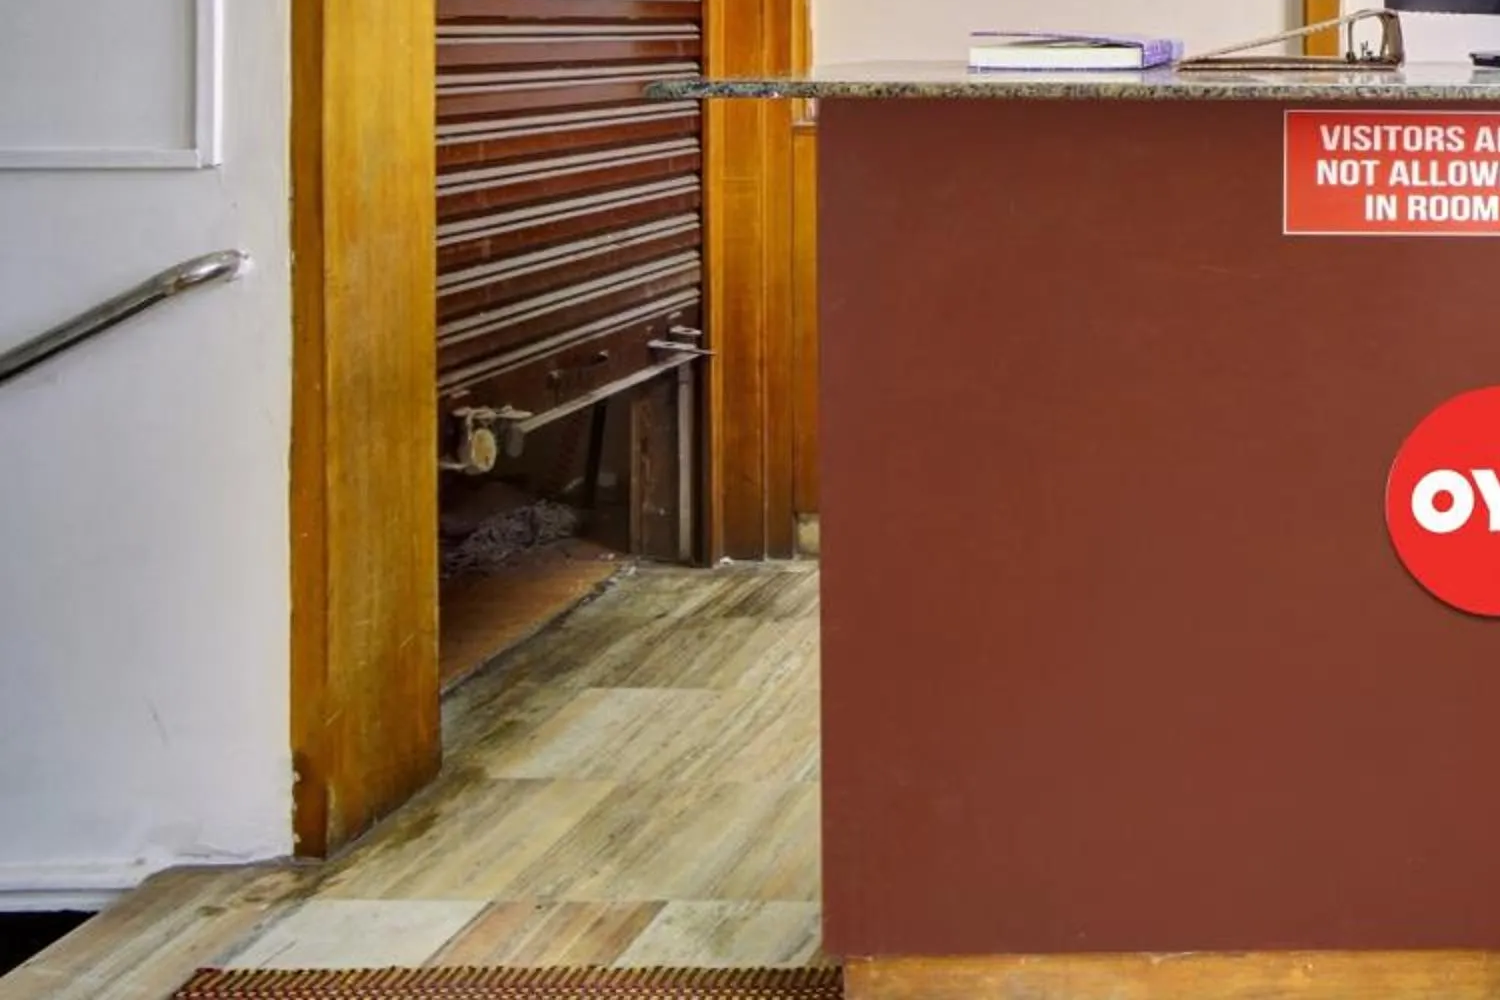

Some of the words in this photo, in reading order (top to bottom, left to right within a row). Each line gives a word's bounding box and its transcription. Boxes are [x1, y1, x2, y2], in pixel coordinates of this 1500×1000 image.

[1320, 125, 1465, 152] VISITORS
[1316, 159, 1380, 185] NOT
[1365, 194, 1398, 220] IN
[1407, 194, 1500, 221] ROOM
